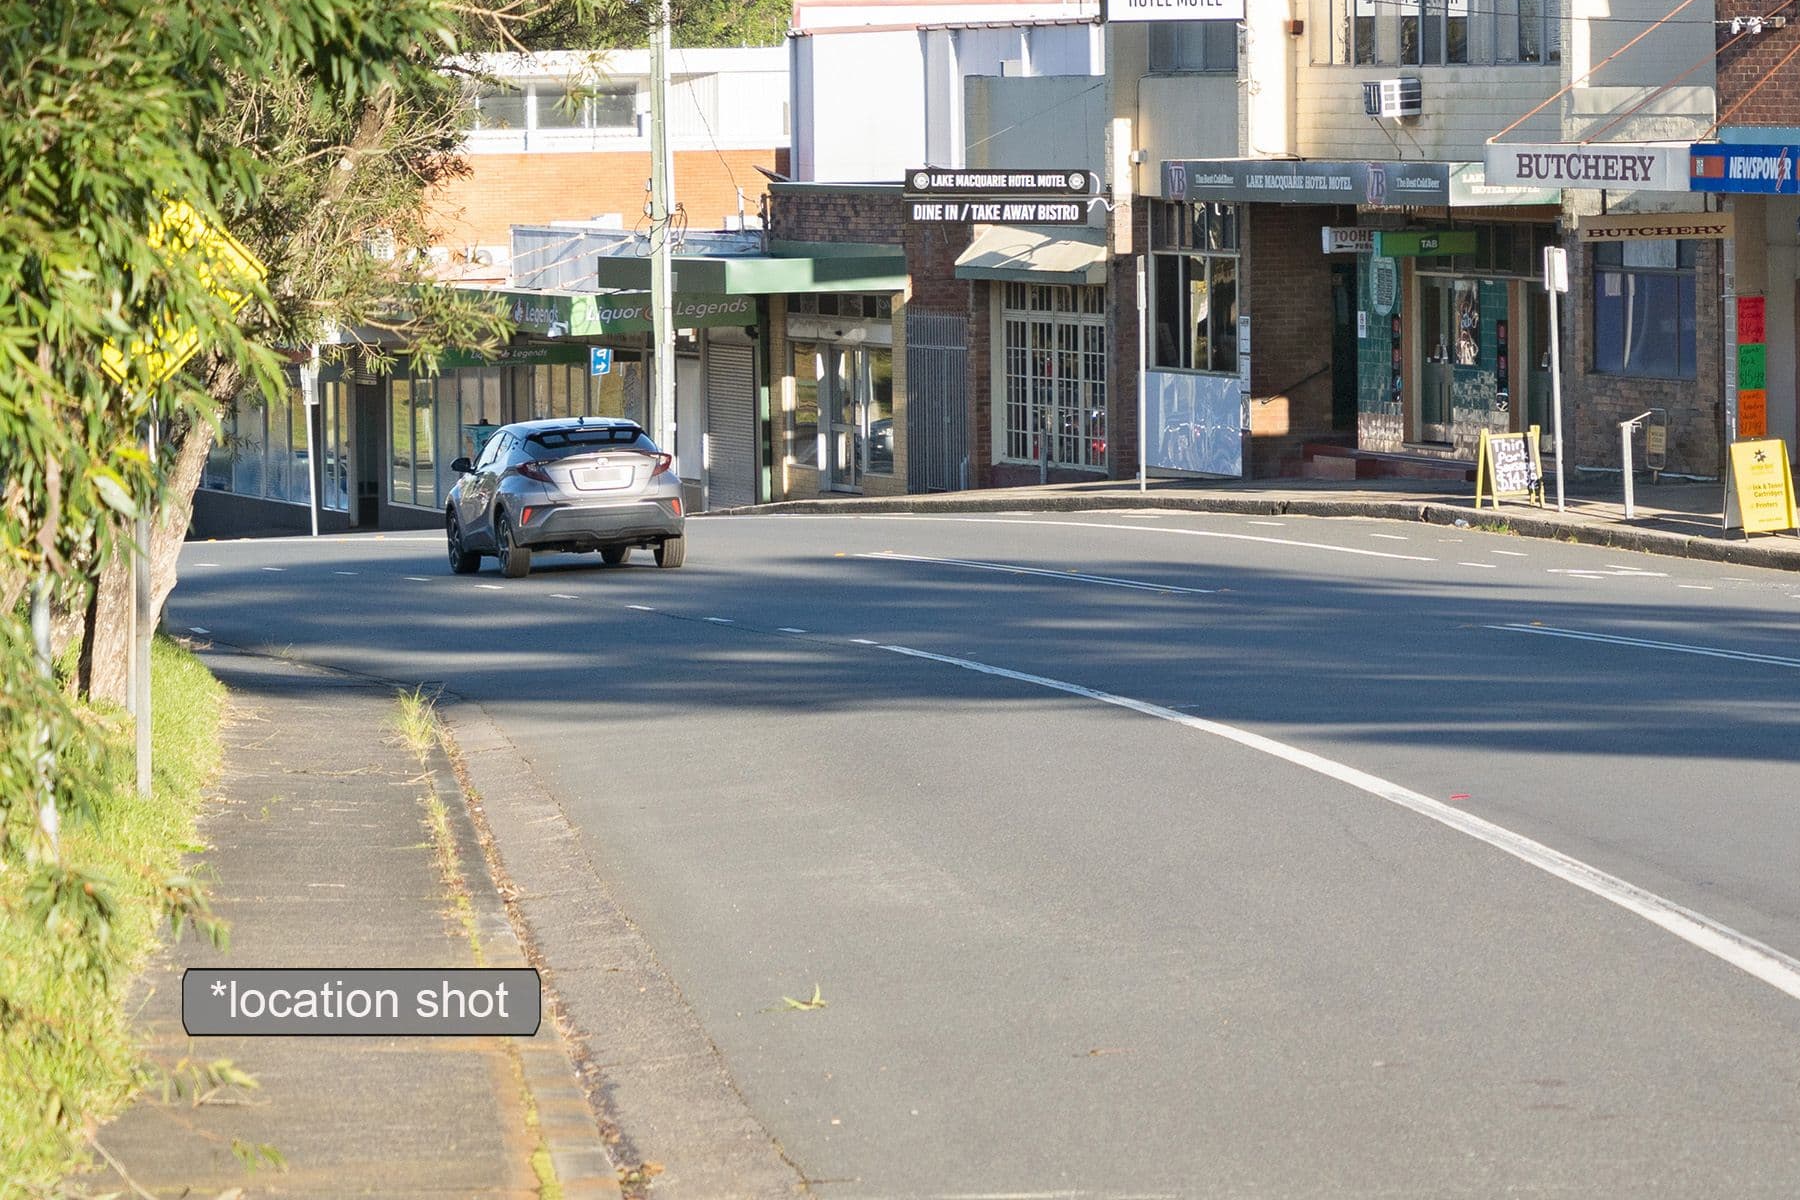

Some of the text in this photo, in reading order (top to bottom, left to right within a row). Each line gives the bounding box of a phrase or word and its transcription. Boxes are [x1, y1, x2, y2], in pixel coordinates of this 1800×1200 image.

[1516, 153, 1655, 182] BUTCHERY
[931, 174, 956, 187] LAKE
[956, 174, 1007, 188] MACQUARIE
[1008, 175, 1036, 187] HOTEL
[1038, 175, 1067, 187] MOTEL
[1246, 175, 1352, 190] LAKE MACQUARIE HOTEL MOTEL
[913, 204, 1079, 221] DINE IN / TAKE AWAY BISTRO
[1333, 230, 1374, 242] TOOHE
[1586, 225, 1727, 238] BUTCHERY
[1421, 240, 1438, 249] TAB
[587, 301, 749, 324] Liquor Legends
[1491, 438, 1525, 452] Thin
[1497, 451, 1528, 463] Pork
